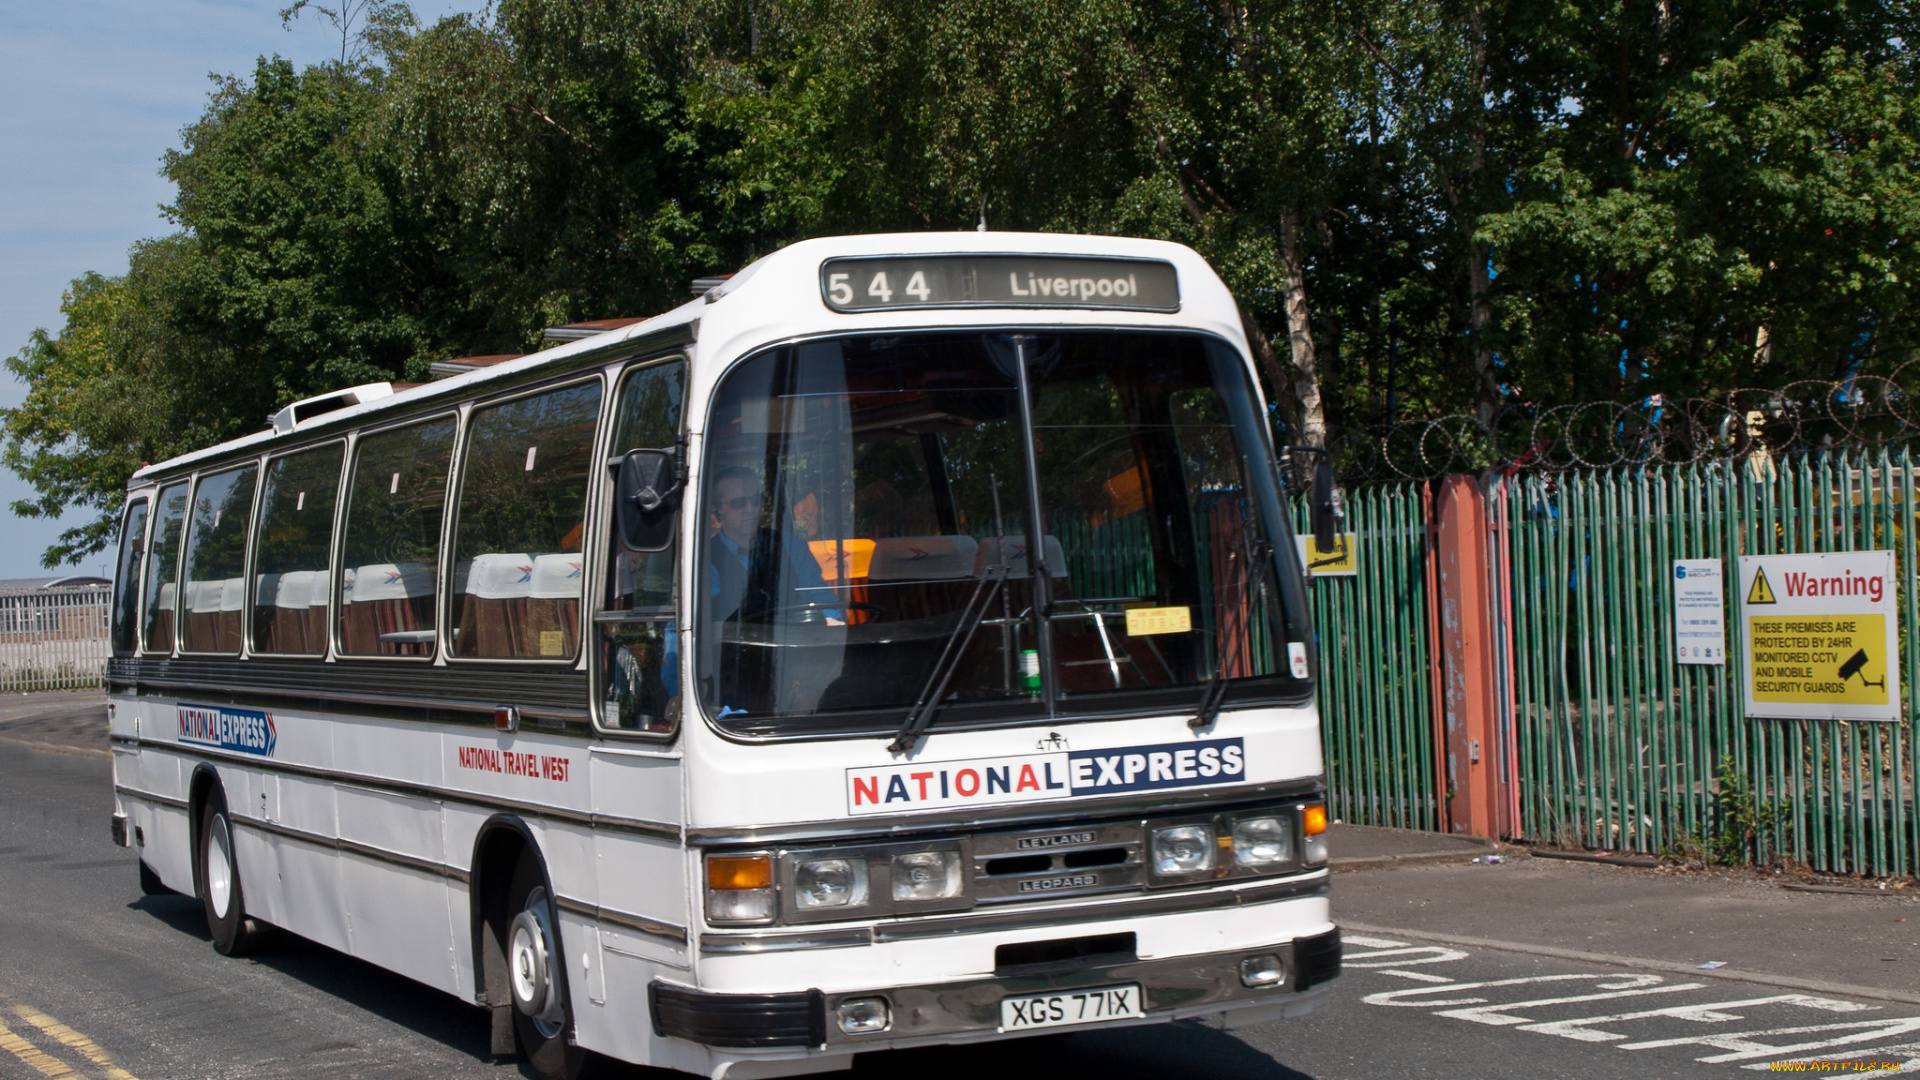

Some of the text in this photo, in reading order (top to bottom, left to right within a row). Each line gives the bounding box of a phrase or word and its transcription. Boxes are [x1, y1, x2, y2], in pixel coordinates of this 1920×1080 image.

[1010, 272, 1137, 300] Liverpool
[1784, 569, 1883, 603] Warning
[1753, 621, 1856, 633] THESE PREMISES ARE
[1754, 637, 1852, 648] PROTECTED BY 24HR
[1755, 652, 1838, 663] MONITORED CCTV
[1756, 667, 1813, 678] AND MOBILE
[1756, 681, 1845, 693] SECURITY GUARDS
[179, 709, 266, 750] NATIONAL EXPRESS
[459, 746, 569, 782] NATIONAL TRAVEL WEST
[853, 744, 1244, 806] NATIONAL EXPRESS
[1021, 833, 1092, 848] LEYLAND
[1023, 876, 1095, 891] LEOPARD
[1011, 990, 1130, 1026] XGS 771X
